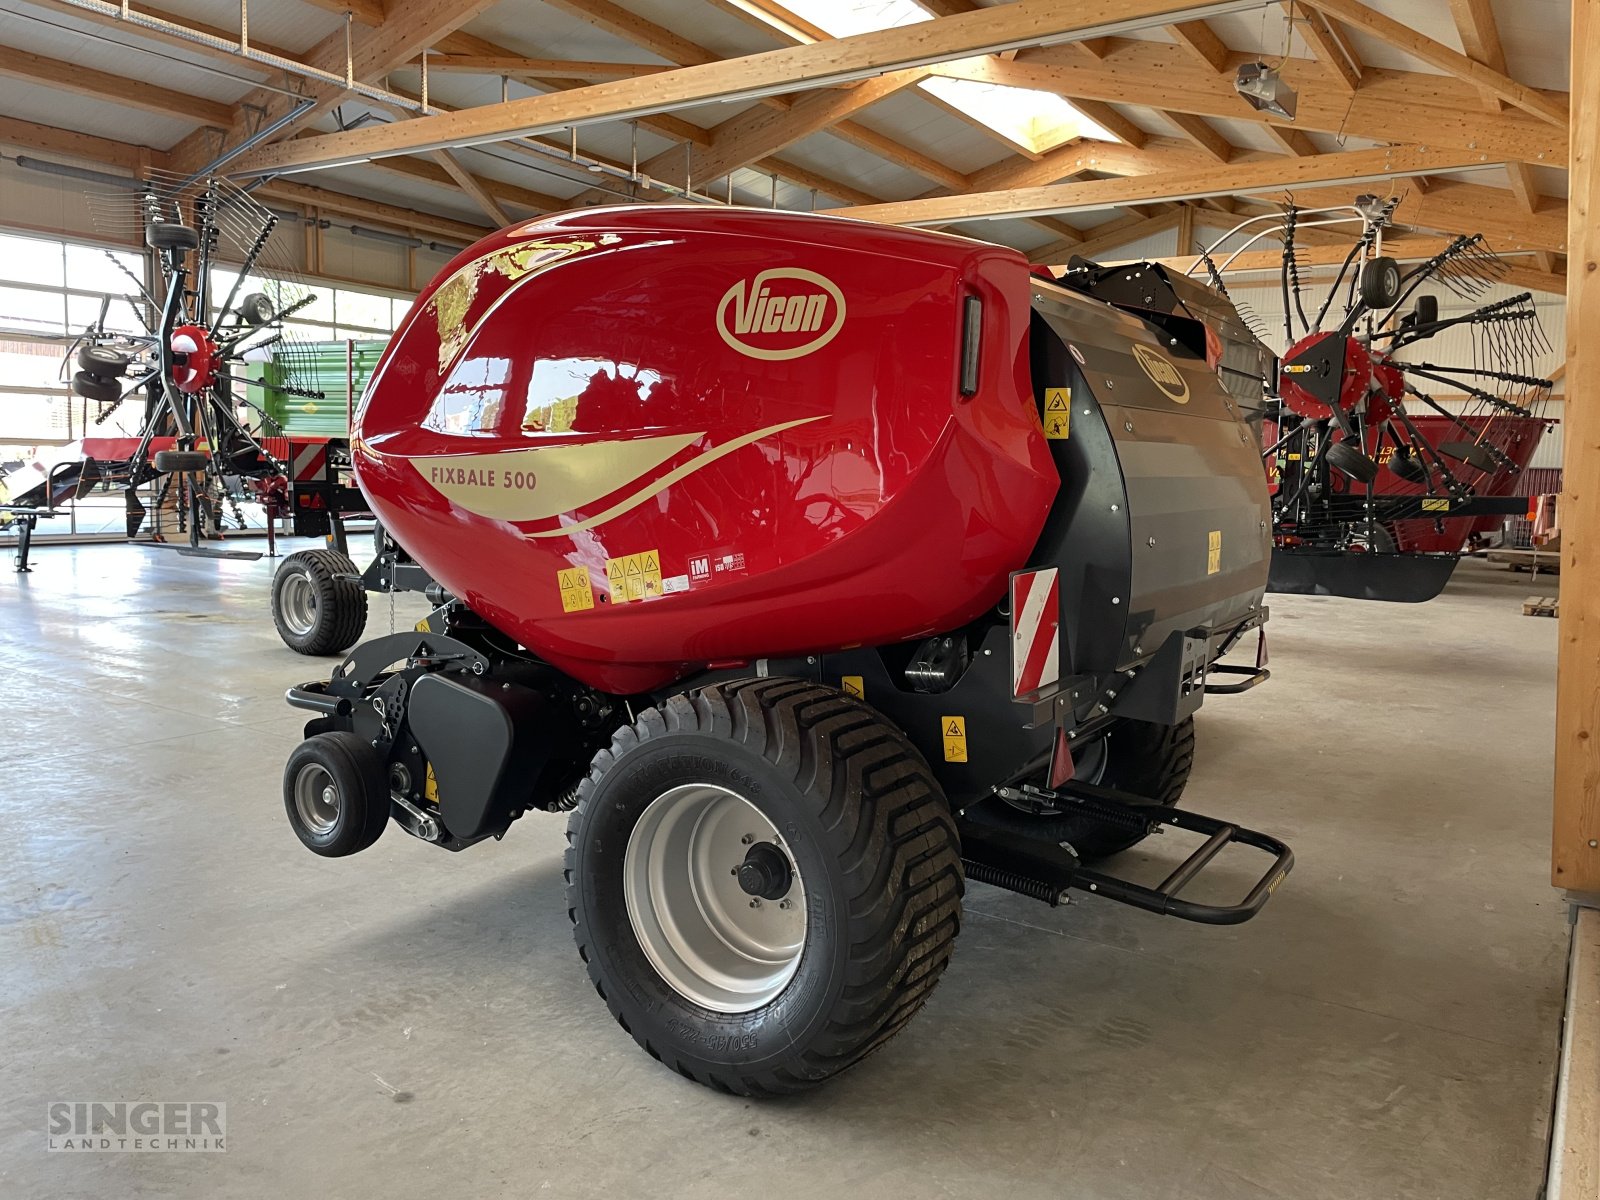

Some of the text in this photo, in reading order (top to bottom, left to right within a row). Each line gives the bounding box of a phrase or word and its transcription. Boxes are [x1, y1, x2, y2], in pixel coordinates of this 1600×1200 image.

[733, 271, 829, 335] Vicon
[431, 467, 537, 490] FIXBALE 500
